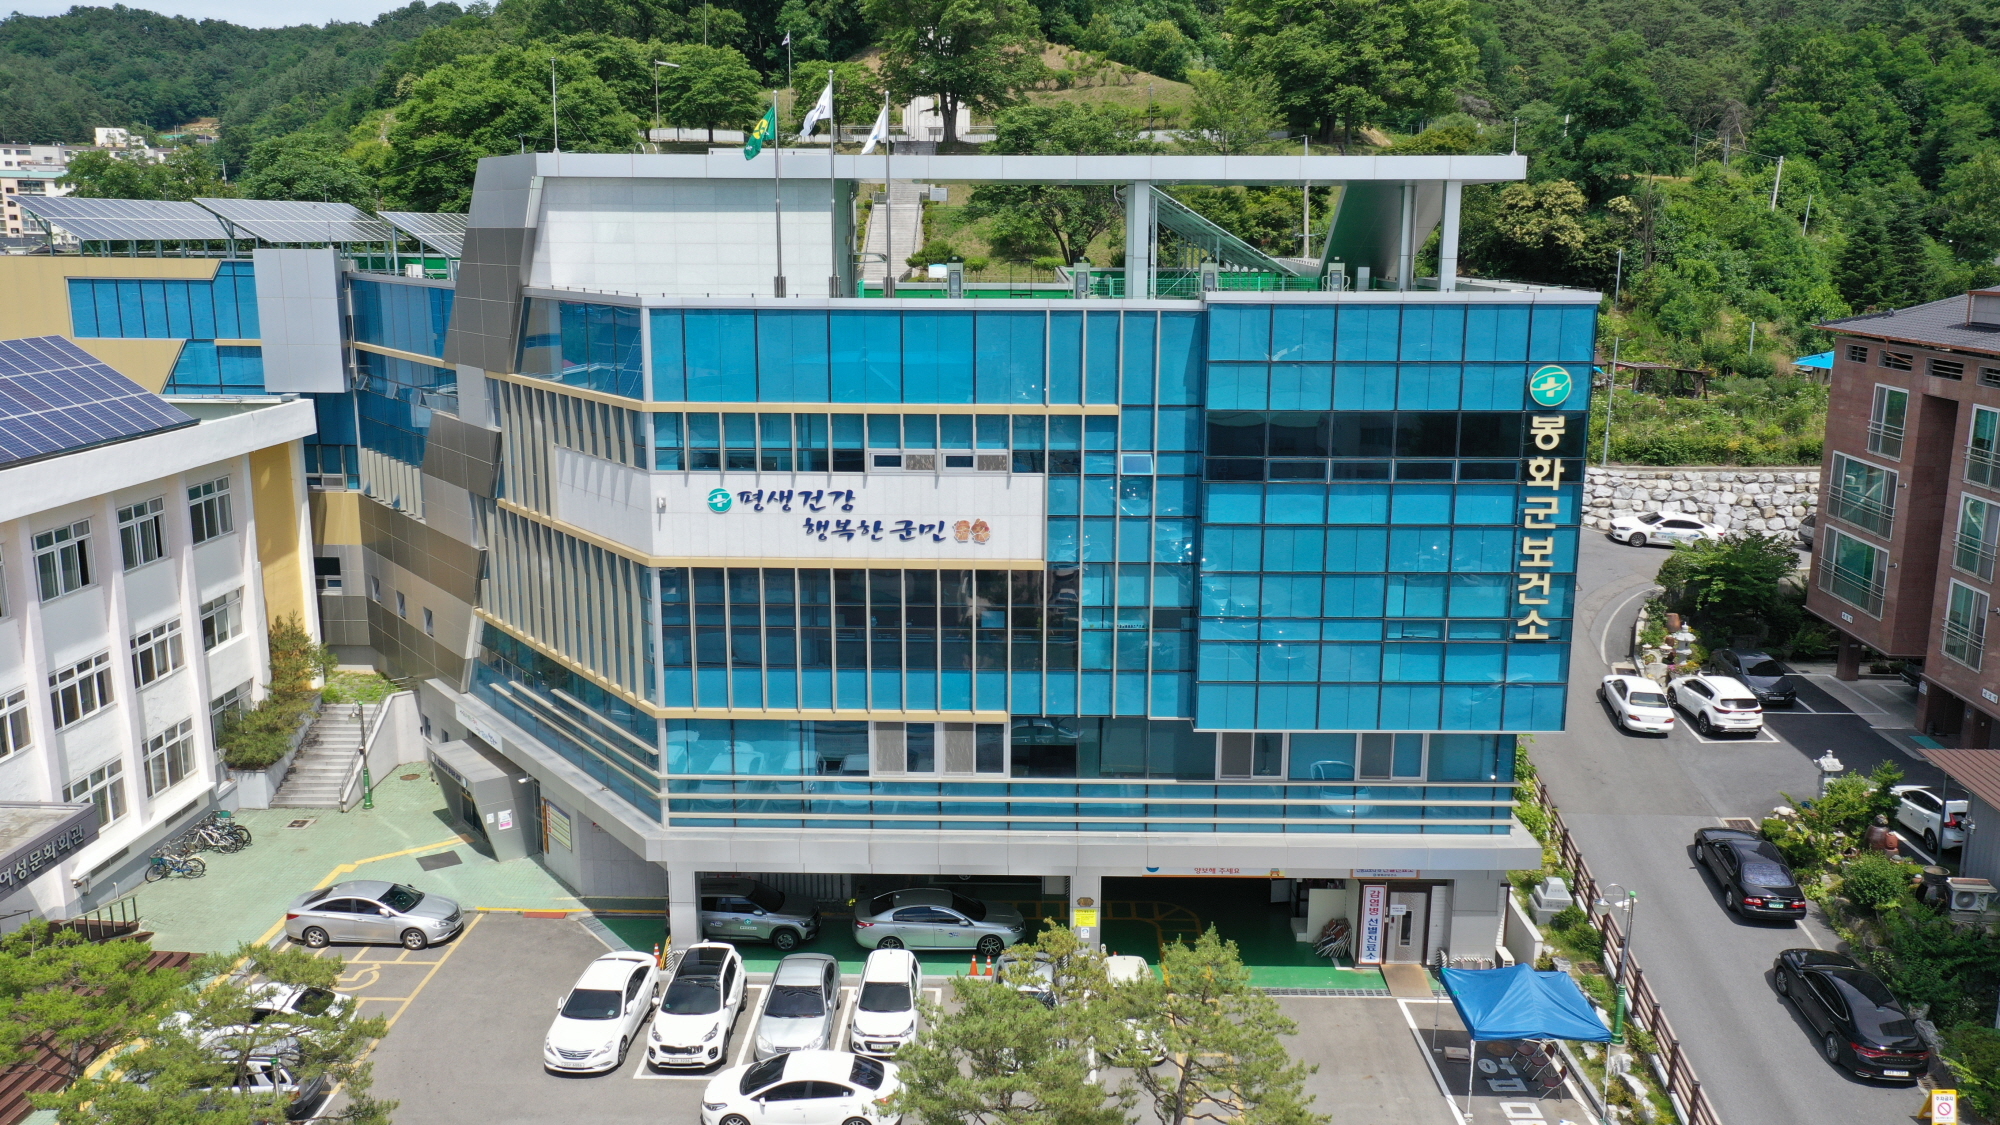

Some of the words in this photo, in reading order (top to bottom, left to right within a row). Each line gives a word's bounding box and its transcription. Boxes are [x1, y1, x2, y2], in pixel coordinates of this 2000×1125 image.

[803, 517, 884, 542] 행복한
[889, 520, 946, 542] 군민
[1515, 415, 1565, 640] 봉화군보건소
[0, 824, 84, 886] 여성문화회관
